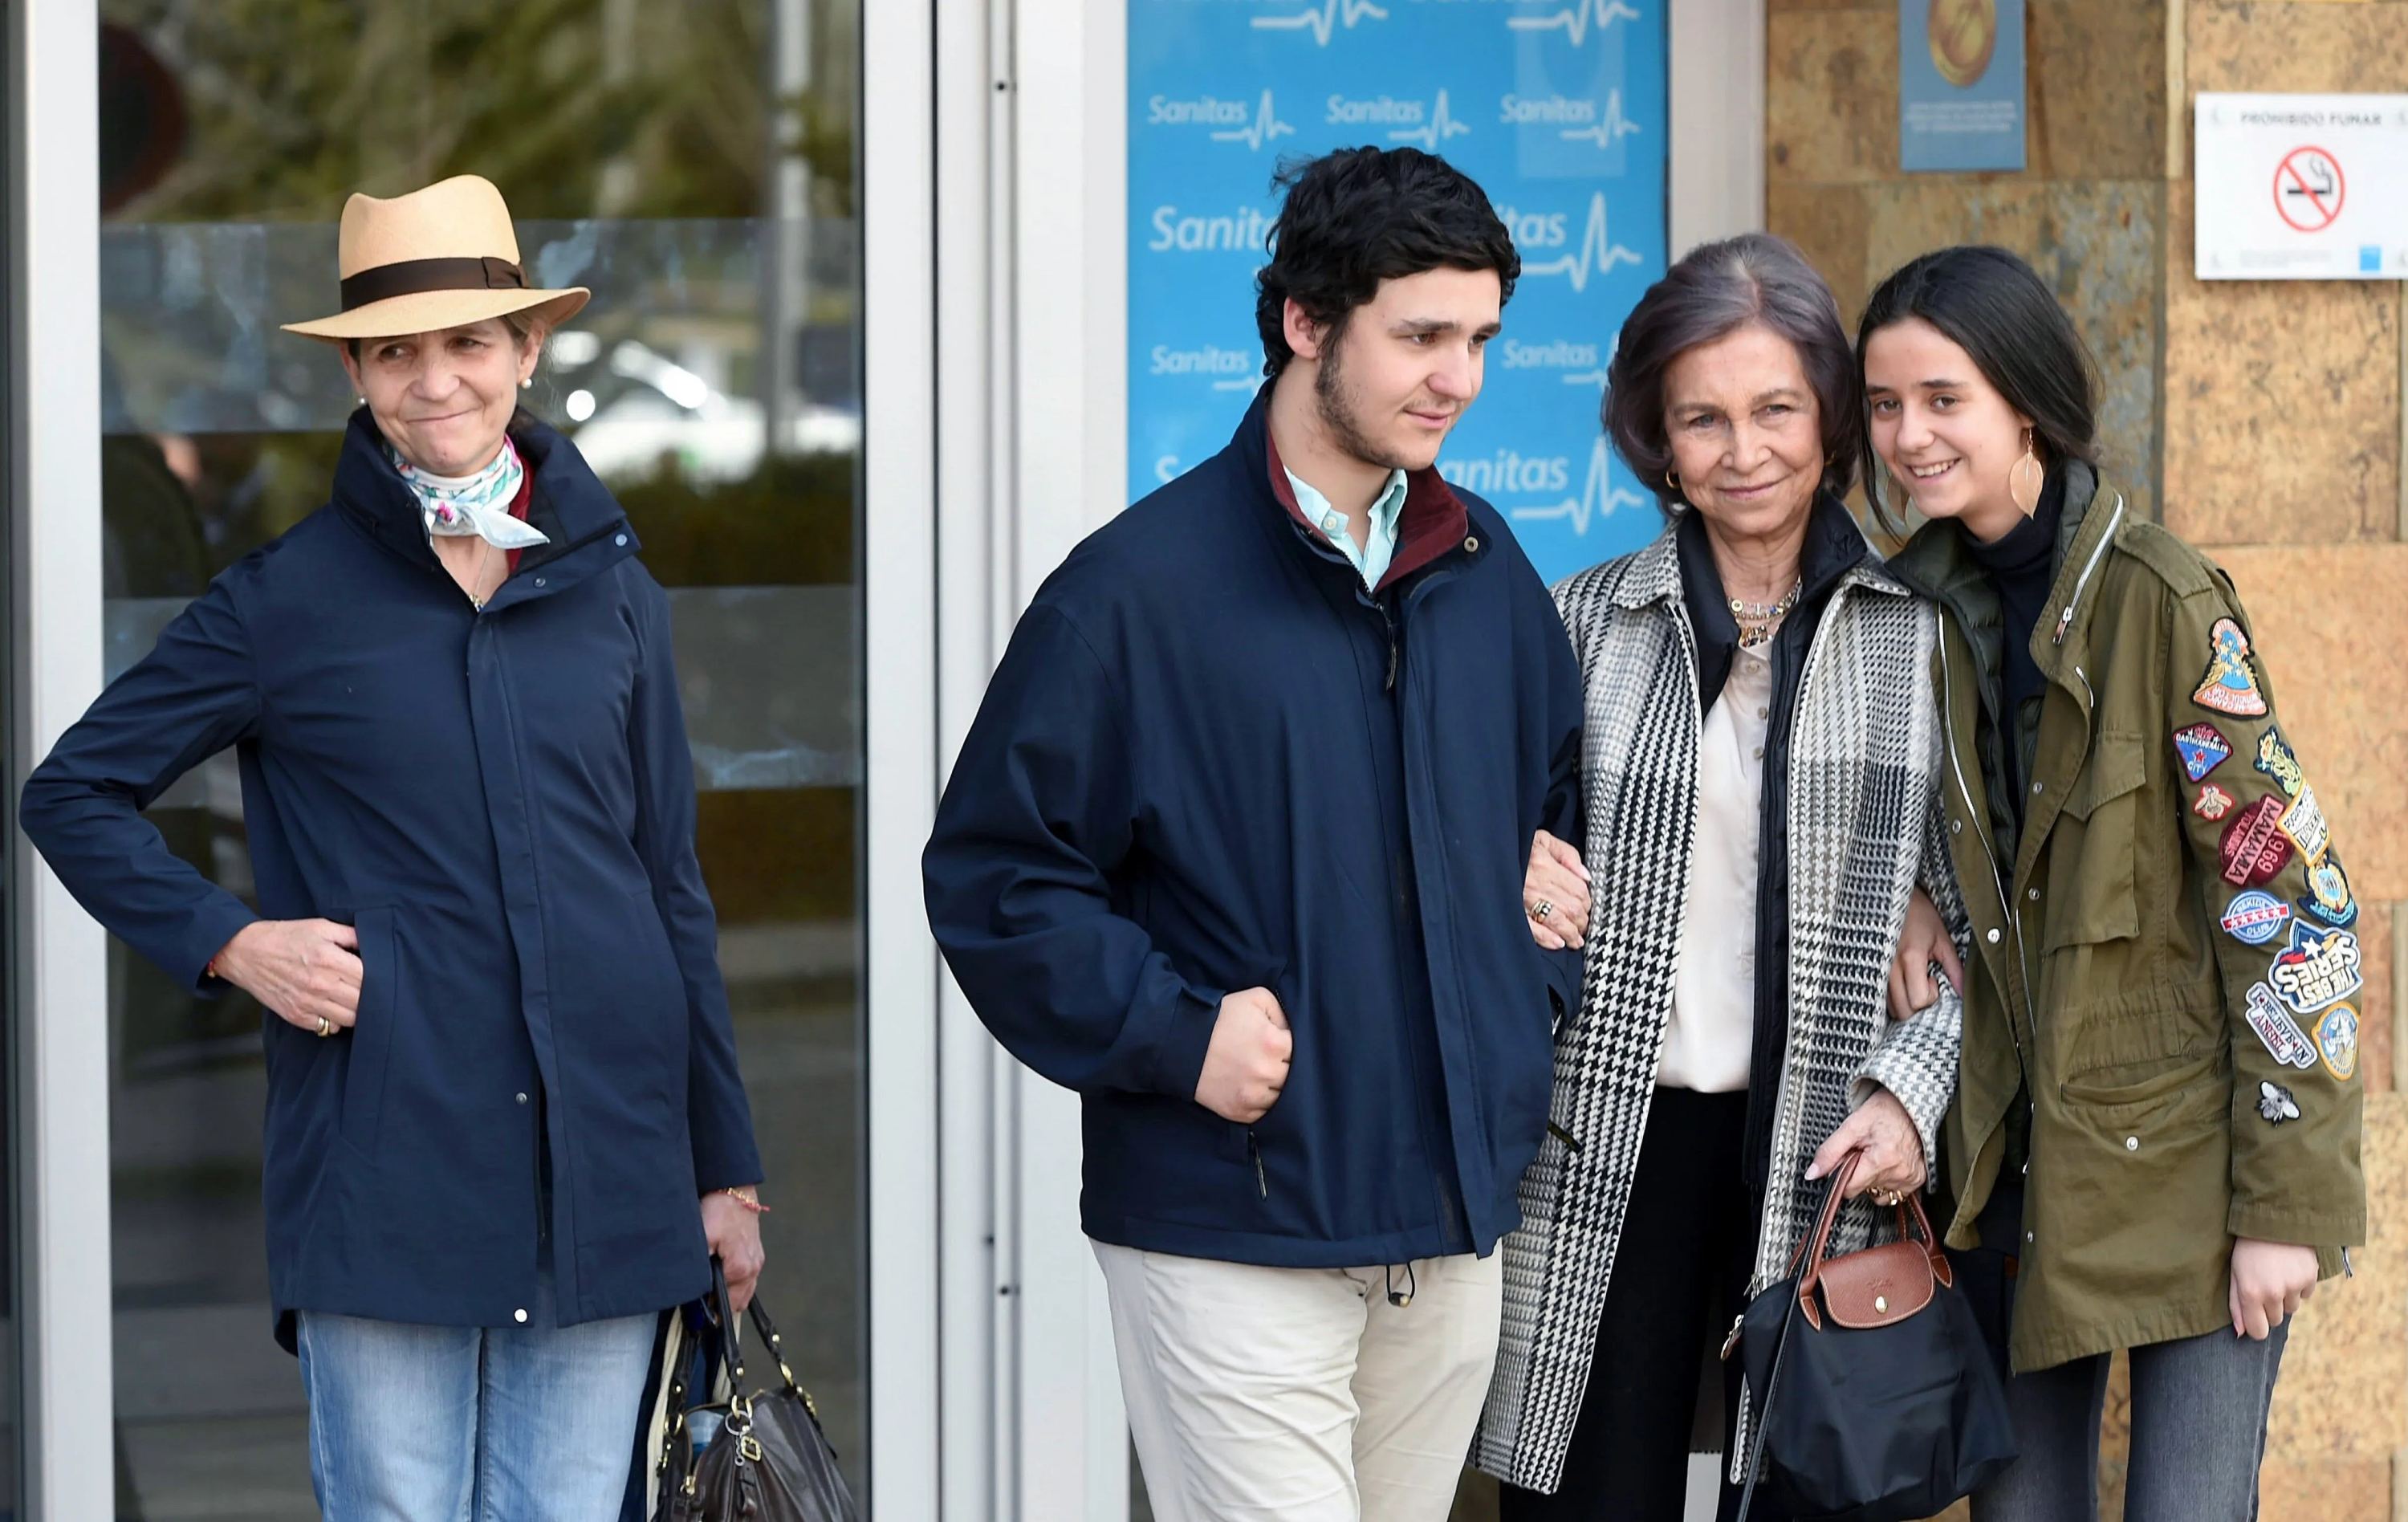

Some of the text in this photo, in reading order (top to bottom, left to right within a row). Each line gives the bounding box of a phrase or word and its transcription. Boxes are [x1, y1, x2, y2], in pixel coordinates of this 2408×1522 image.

[1148, 95, 1248, 125] Sanitas
[1326, 95, 1424, 125] Sanitas
[1500, 95, 1596, 125] Sanitas
[2241, 112, 2382, 127] PROHIBIDO FUMAR
[1149, 206, 1279, 251] Sanit
[1151, 345, 1250, 376] Sanitas
[1503, 340, 1598, 370] Sanitas
[1441, 448, 1569, 492] anitas
[2187, 761, 2207, 775] CITY
[2258, 829, 2288, 873] 1969
[2274, 938, 2358, 992] SERIES
[2297, 967, 2355, 1008] THE BEST
